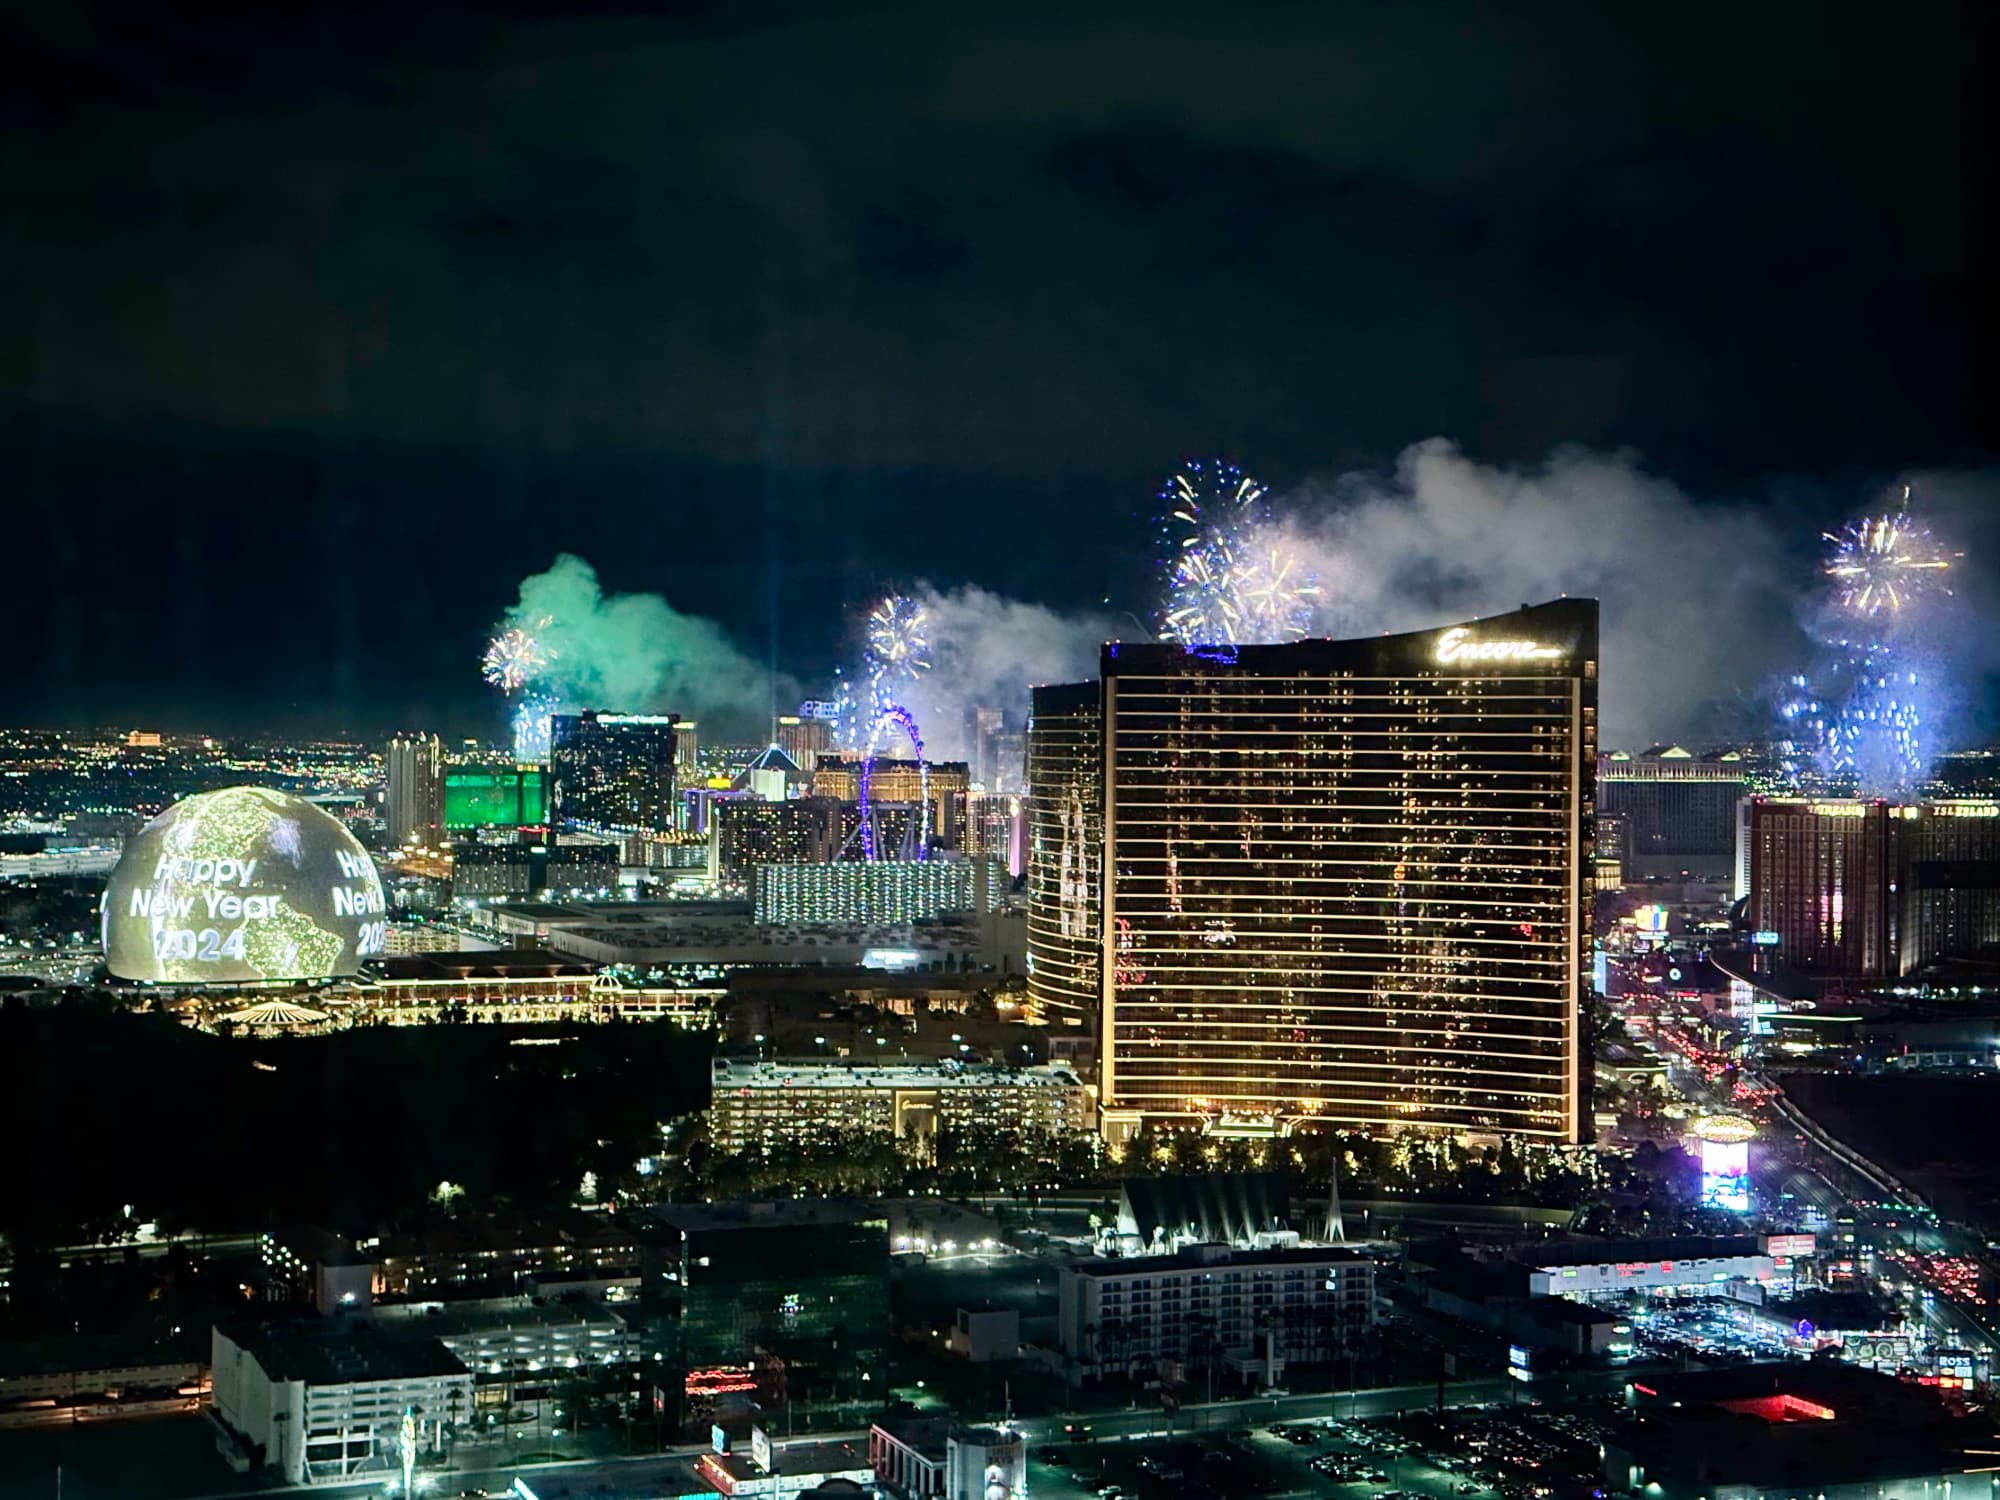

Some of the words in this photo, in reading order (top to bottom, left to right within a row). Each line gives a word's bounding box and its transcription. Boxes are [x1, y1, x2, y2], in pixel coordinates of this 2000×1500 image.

[1437, 627, 1562, 662] Encore
[154, 854, 257, 888] Happy
[130, 889, 195, 918] New
[202, 891, 281, 919] Year
[333, 887, 376, 916] New
[155, 929, 246, 961] 2024
[1939, 1356, 1970, 1367] ROSS
